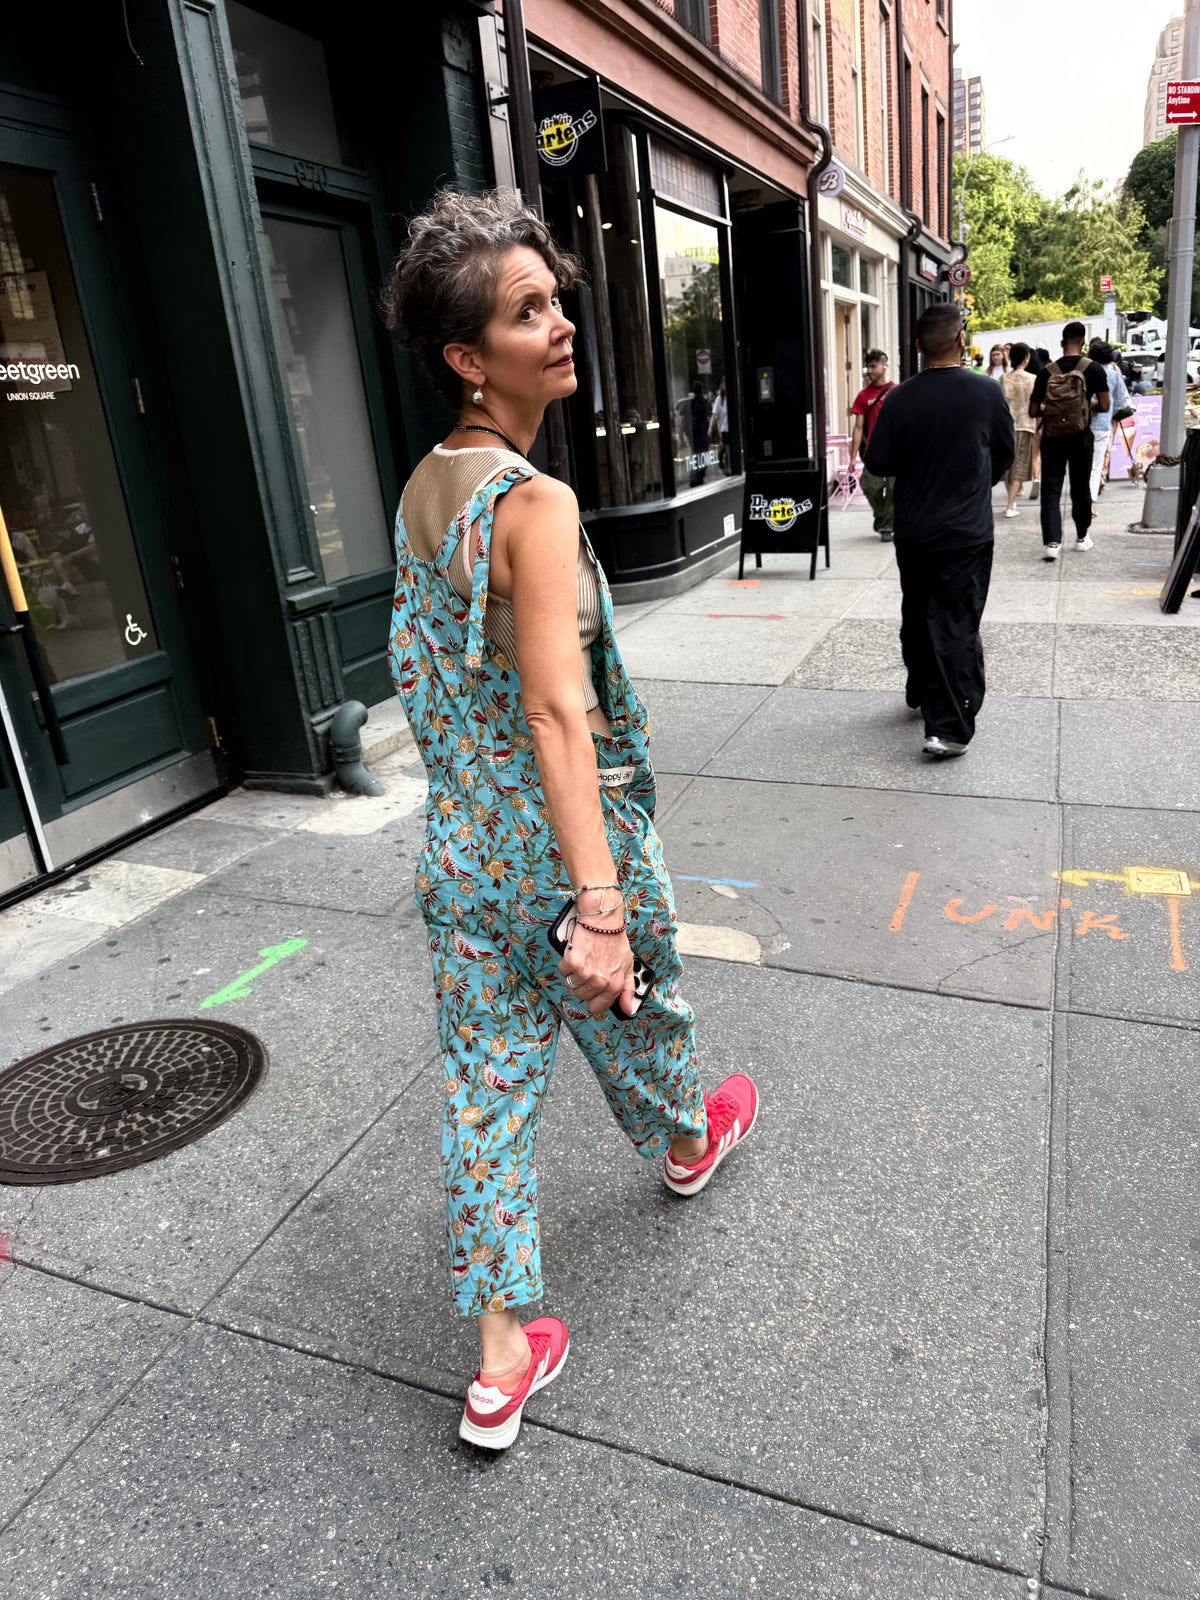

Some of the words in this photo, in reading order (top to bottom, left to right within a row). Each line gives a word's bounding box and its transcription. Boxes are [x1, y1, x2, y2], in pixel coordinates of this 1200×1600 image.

[1168, 86, 1177, 94] NO
[1168, 95, 1190, 106] Anytime
[820, 170, 839, 192] B
[6, 392, 28, 401] UNION
[28, 391, 56, 400] SQUARE
[685, 454, 698, 472] THE
[750, 499, 813, 520] Martens
[471, 1393, 494, 1405] adidas
